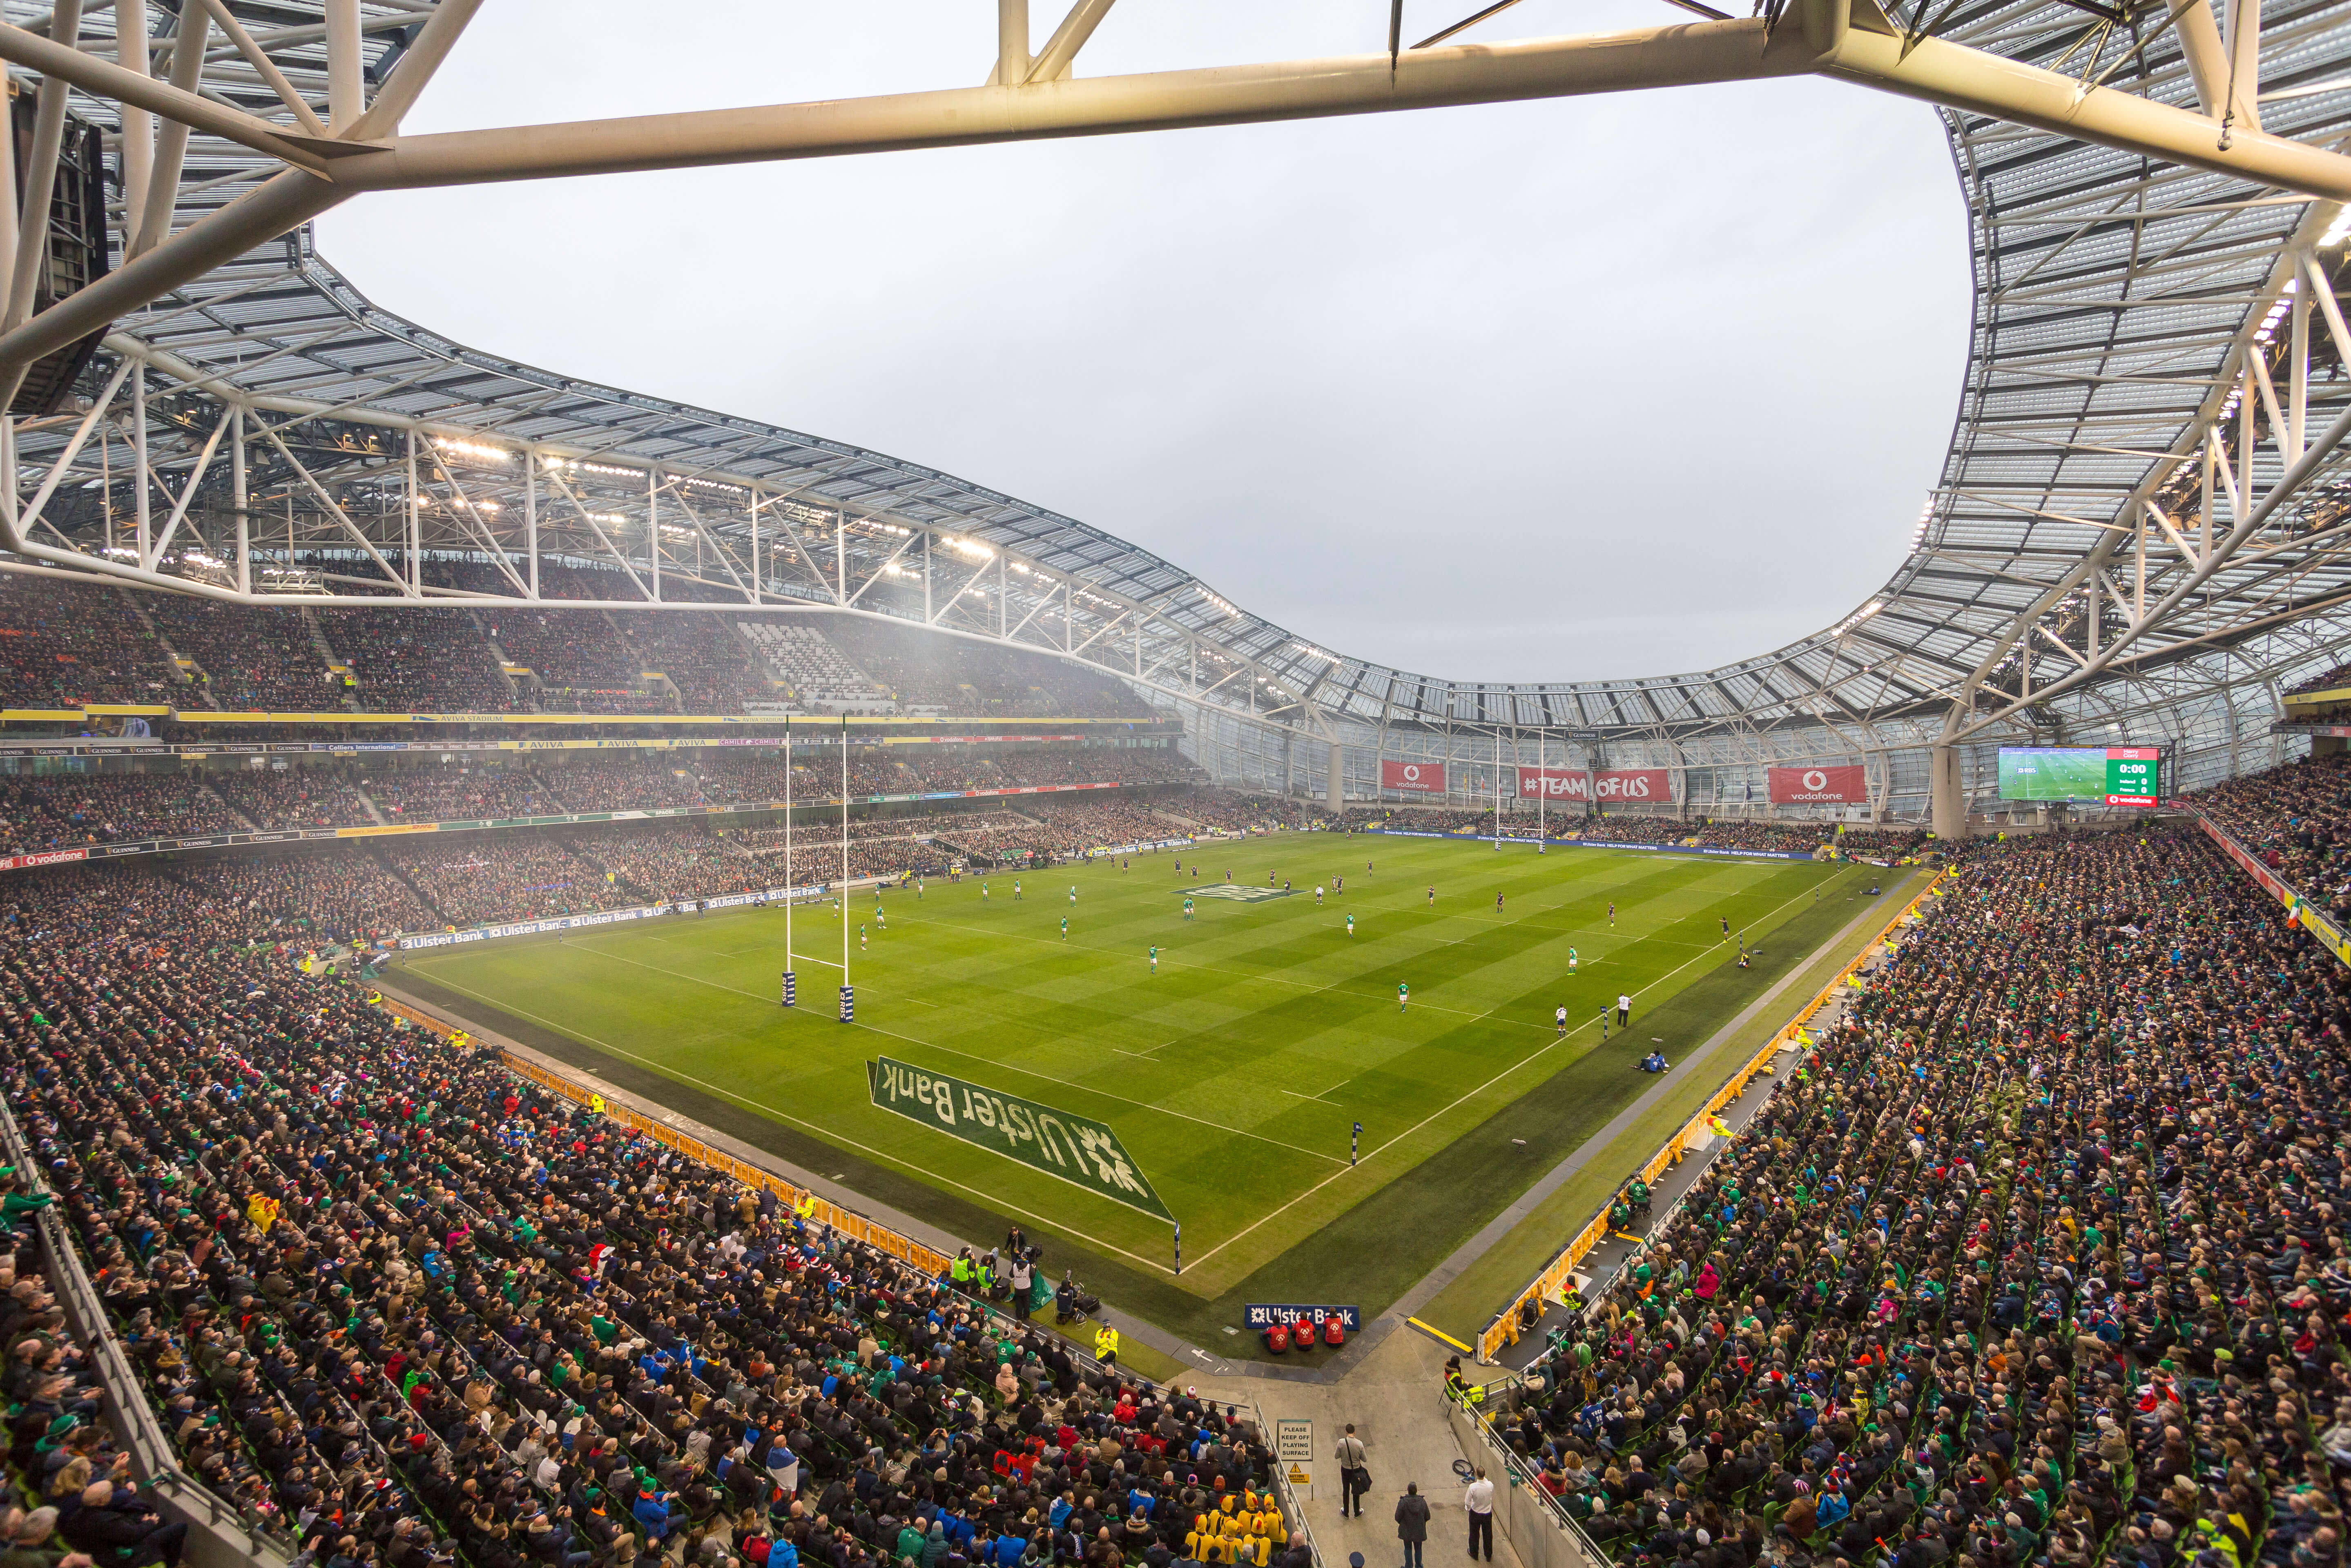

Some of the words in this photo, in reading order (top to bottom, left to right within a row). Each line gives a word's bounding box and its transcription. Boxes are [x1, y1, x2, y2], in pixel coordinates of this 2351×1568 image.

[2119, 764, 2146, 773] 0:00
[1791, 792, 1843, 800] vodafone
[38, 851, 83, 864] vodafone
[718, 897, 744, 906] Ulster
[582, 913, 612, 926] Ulster
[614, 911, 637, 921] Bank
[502, 924, 537, 936] Ulster
[414, 936, 452, 948] Ulster
[455, 930, 485, 943] Bank
[882, 1063, 956, 1125] Bank
[963, 1088, 1091, 1176] Ulster
